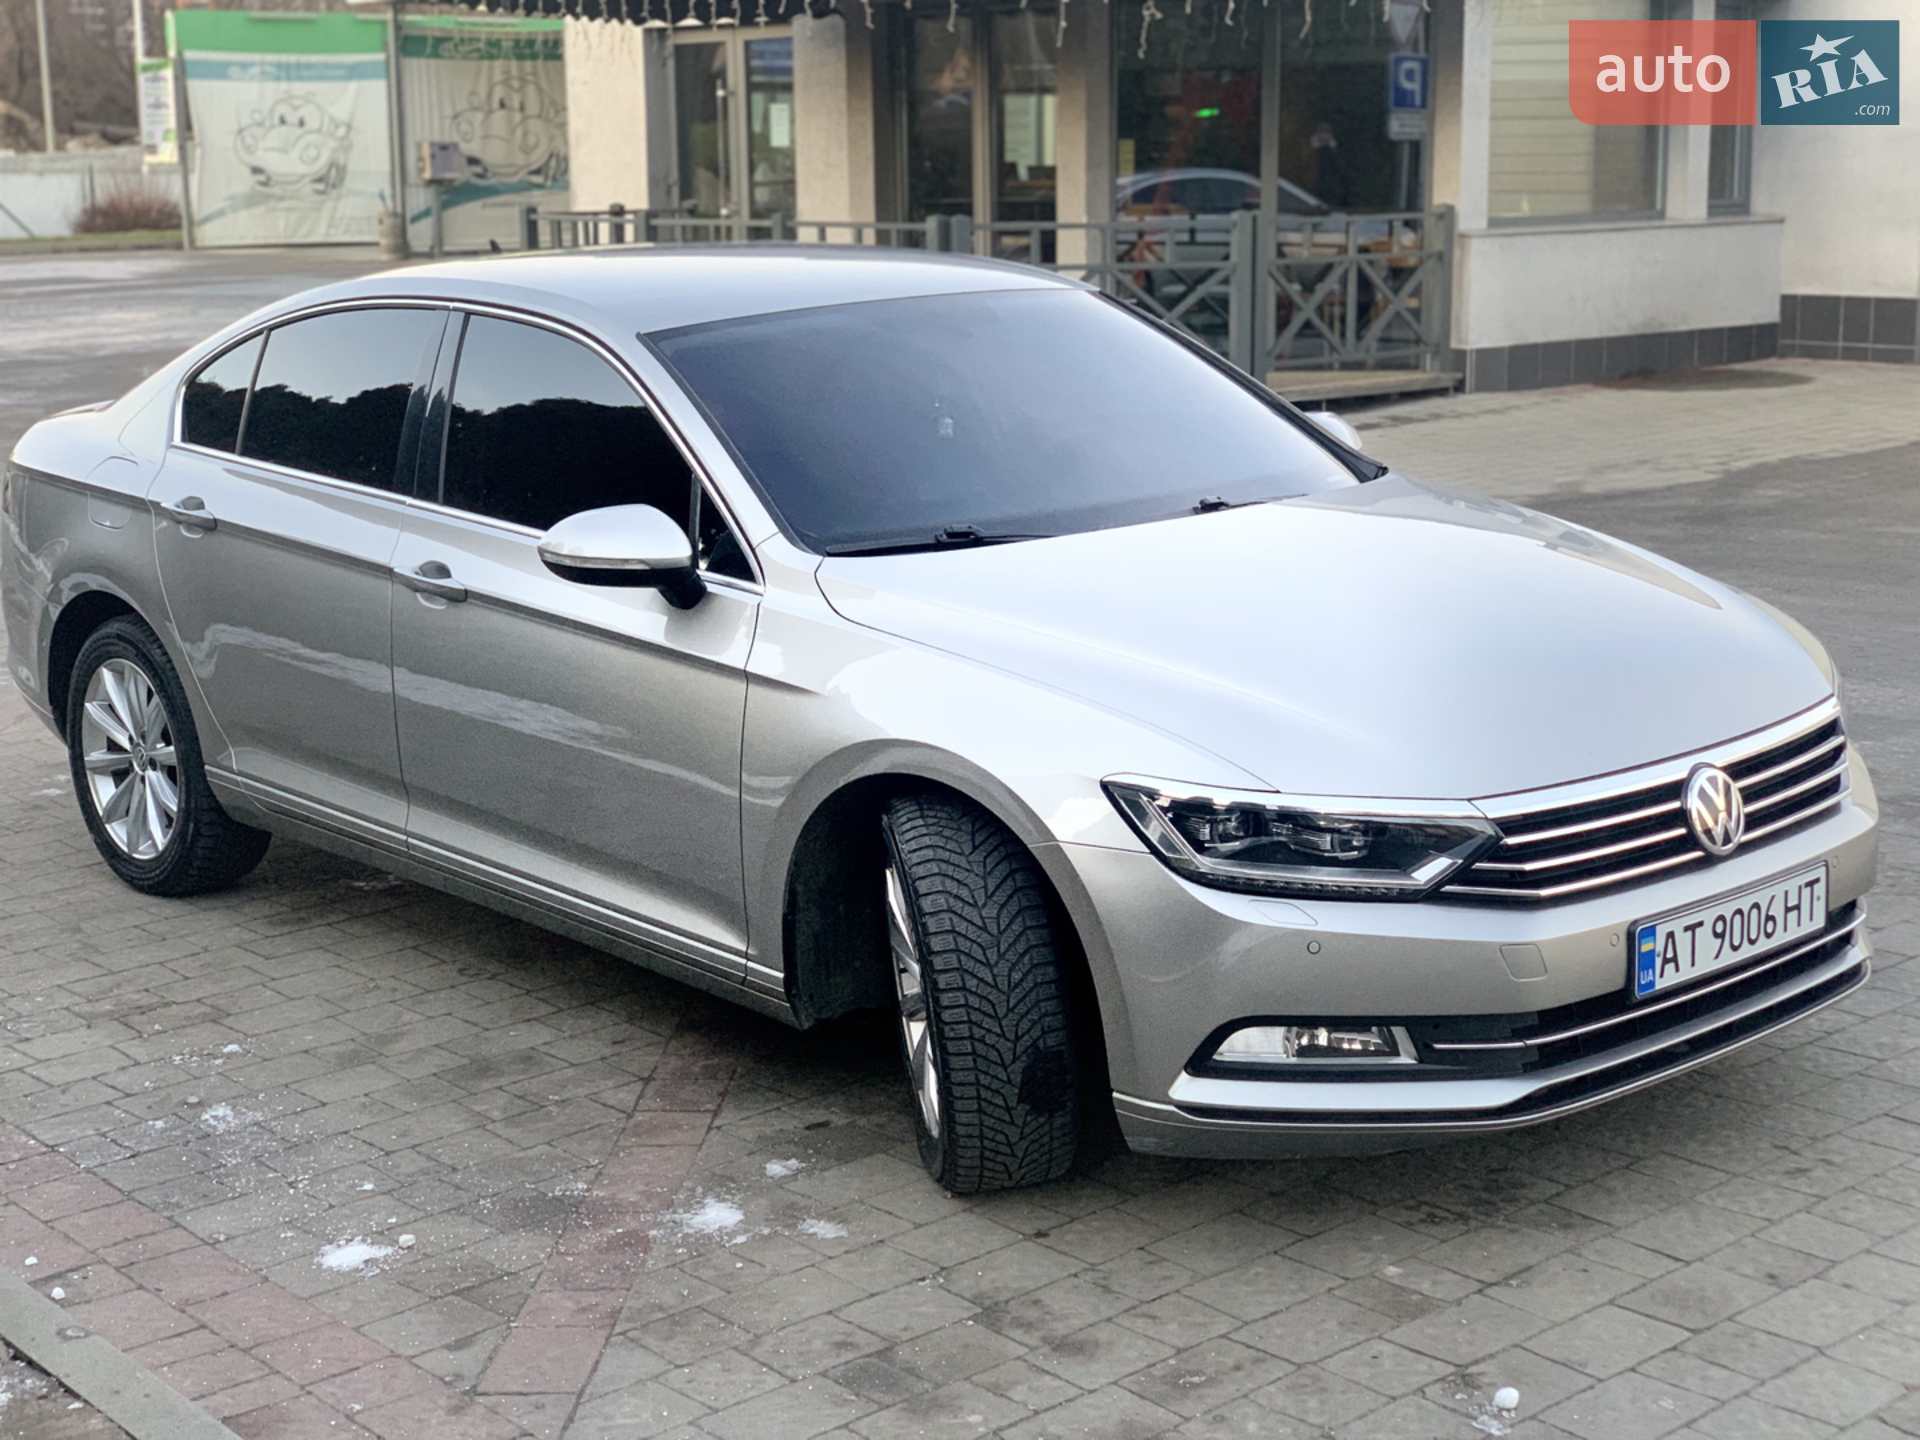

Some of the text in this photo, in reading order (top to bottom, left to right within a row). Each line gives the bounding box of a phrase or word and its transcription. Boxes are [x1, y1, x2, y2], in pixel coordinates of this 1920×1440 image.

[1659, 876, 1821, 979] AT 9006 HT
[1640, 968, 1654, 985] UA
